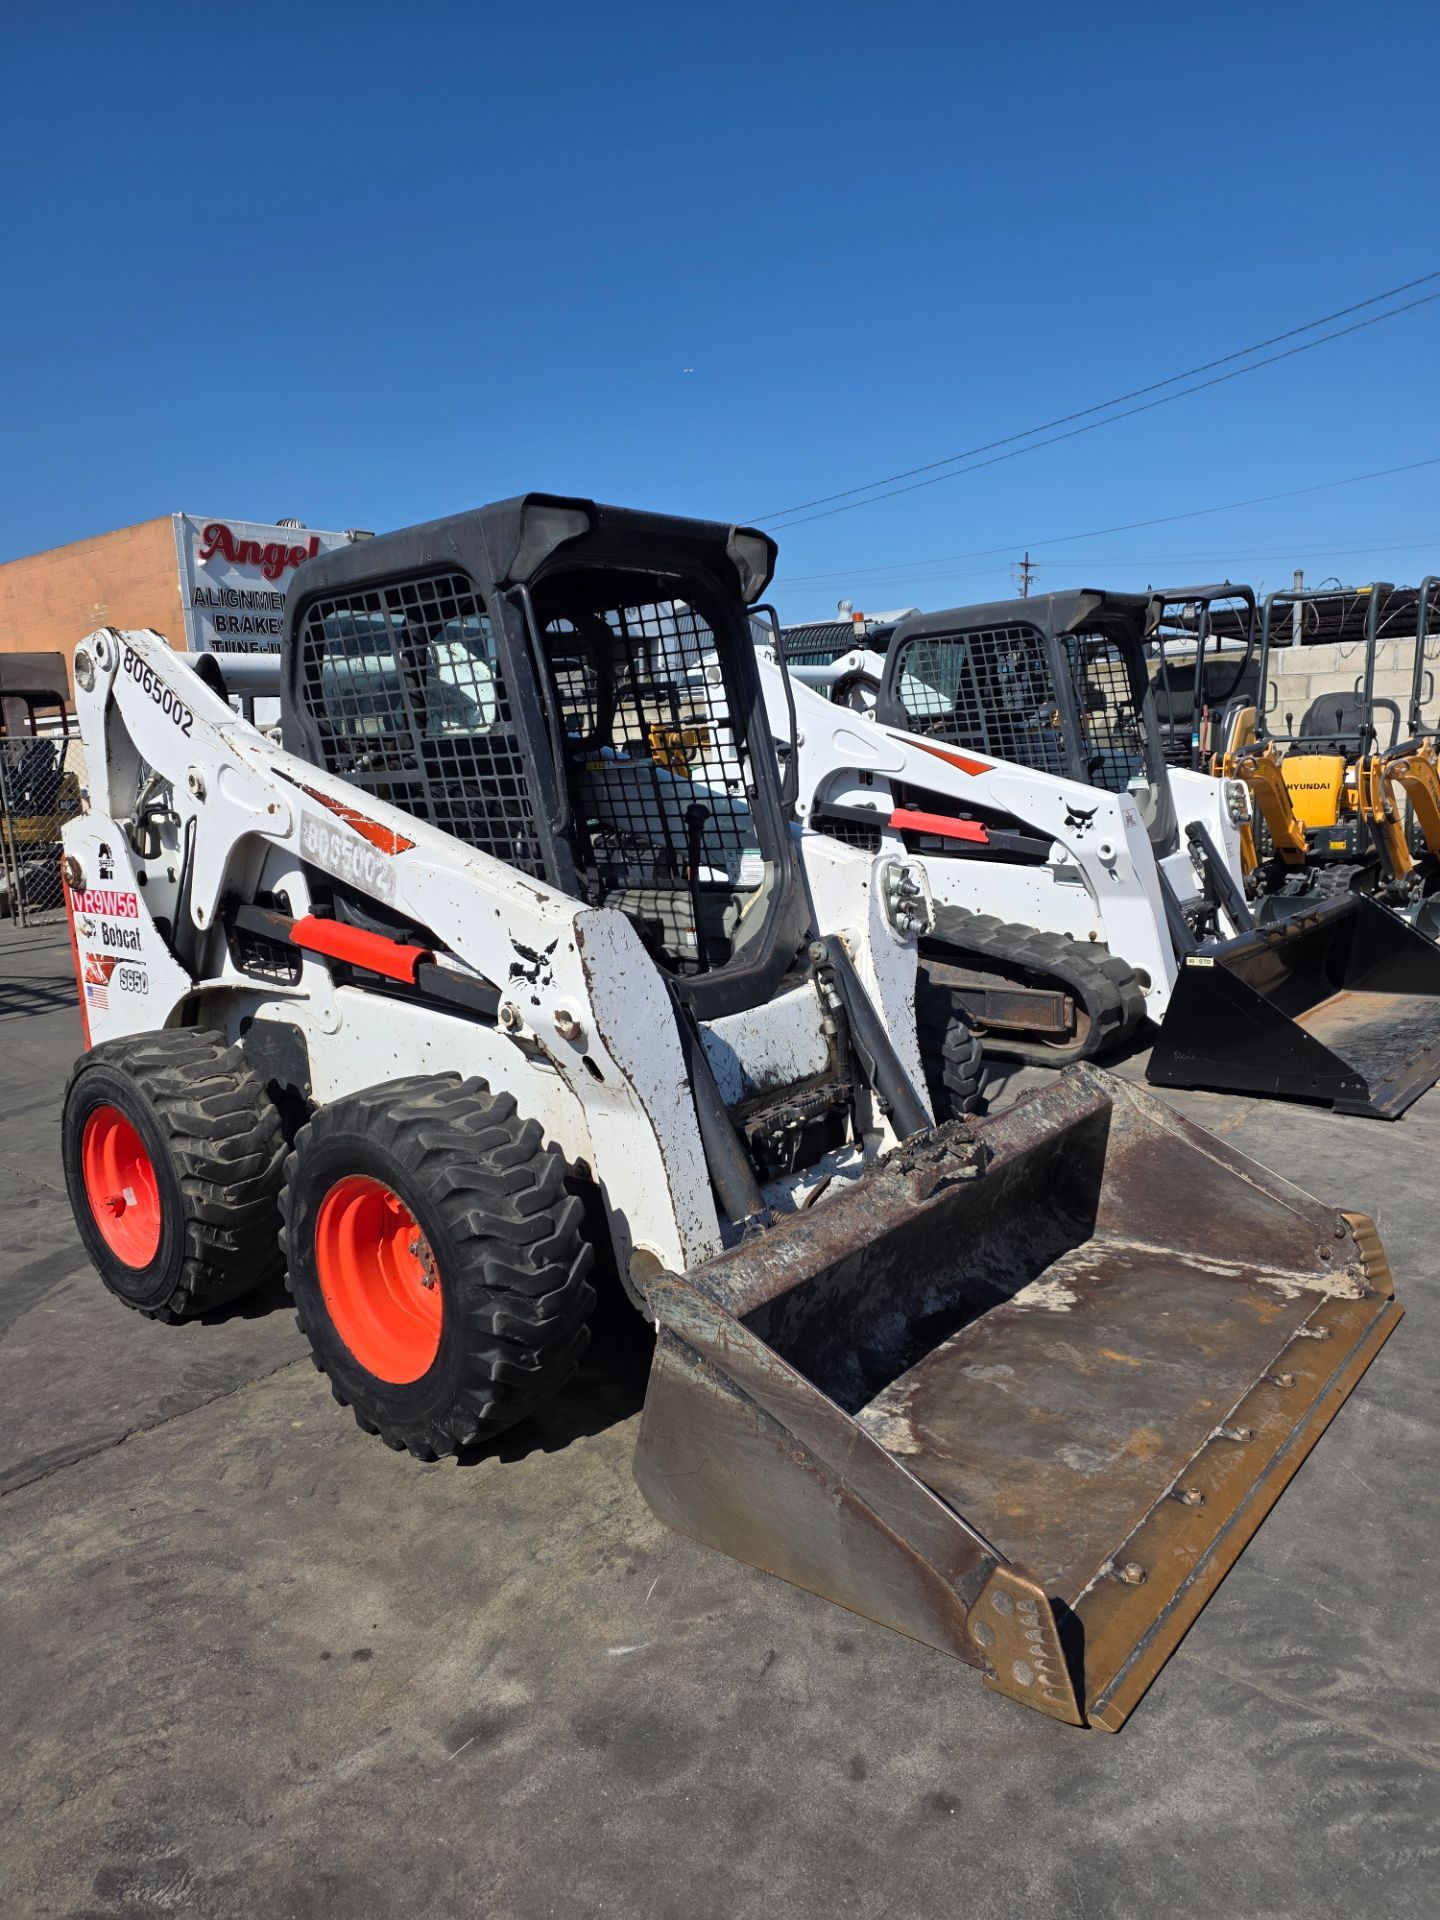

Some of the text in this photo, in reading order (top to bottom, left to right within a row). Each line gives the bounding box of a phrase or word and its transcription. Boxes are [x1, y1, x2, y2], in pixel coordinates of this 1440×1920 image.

[123, 647, 194, 738] 8065002
[73, 889, 137, 918] VR9W56
[101, 921, 142, 952] Bobcat
[119, 967, 149, 995] S650
